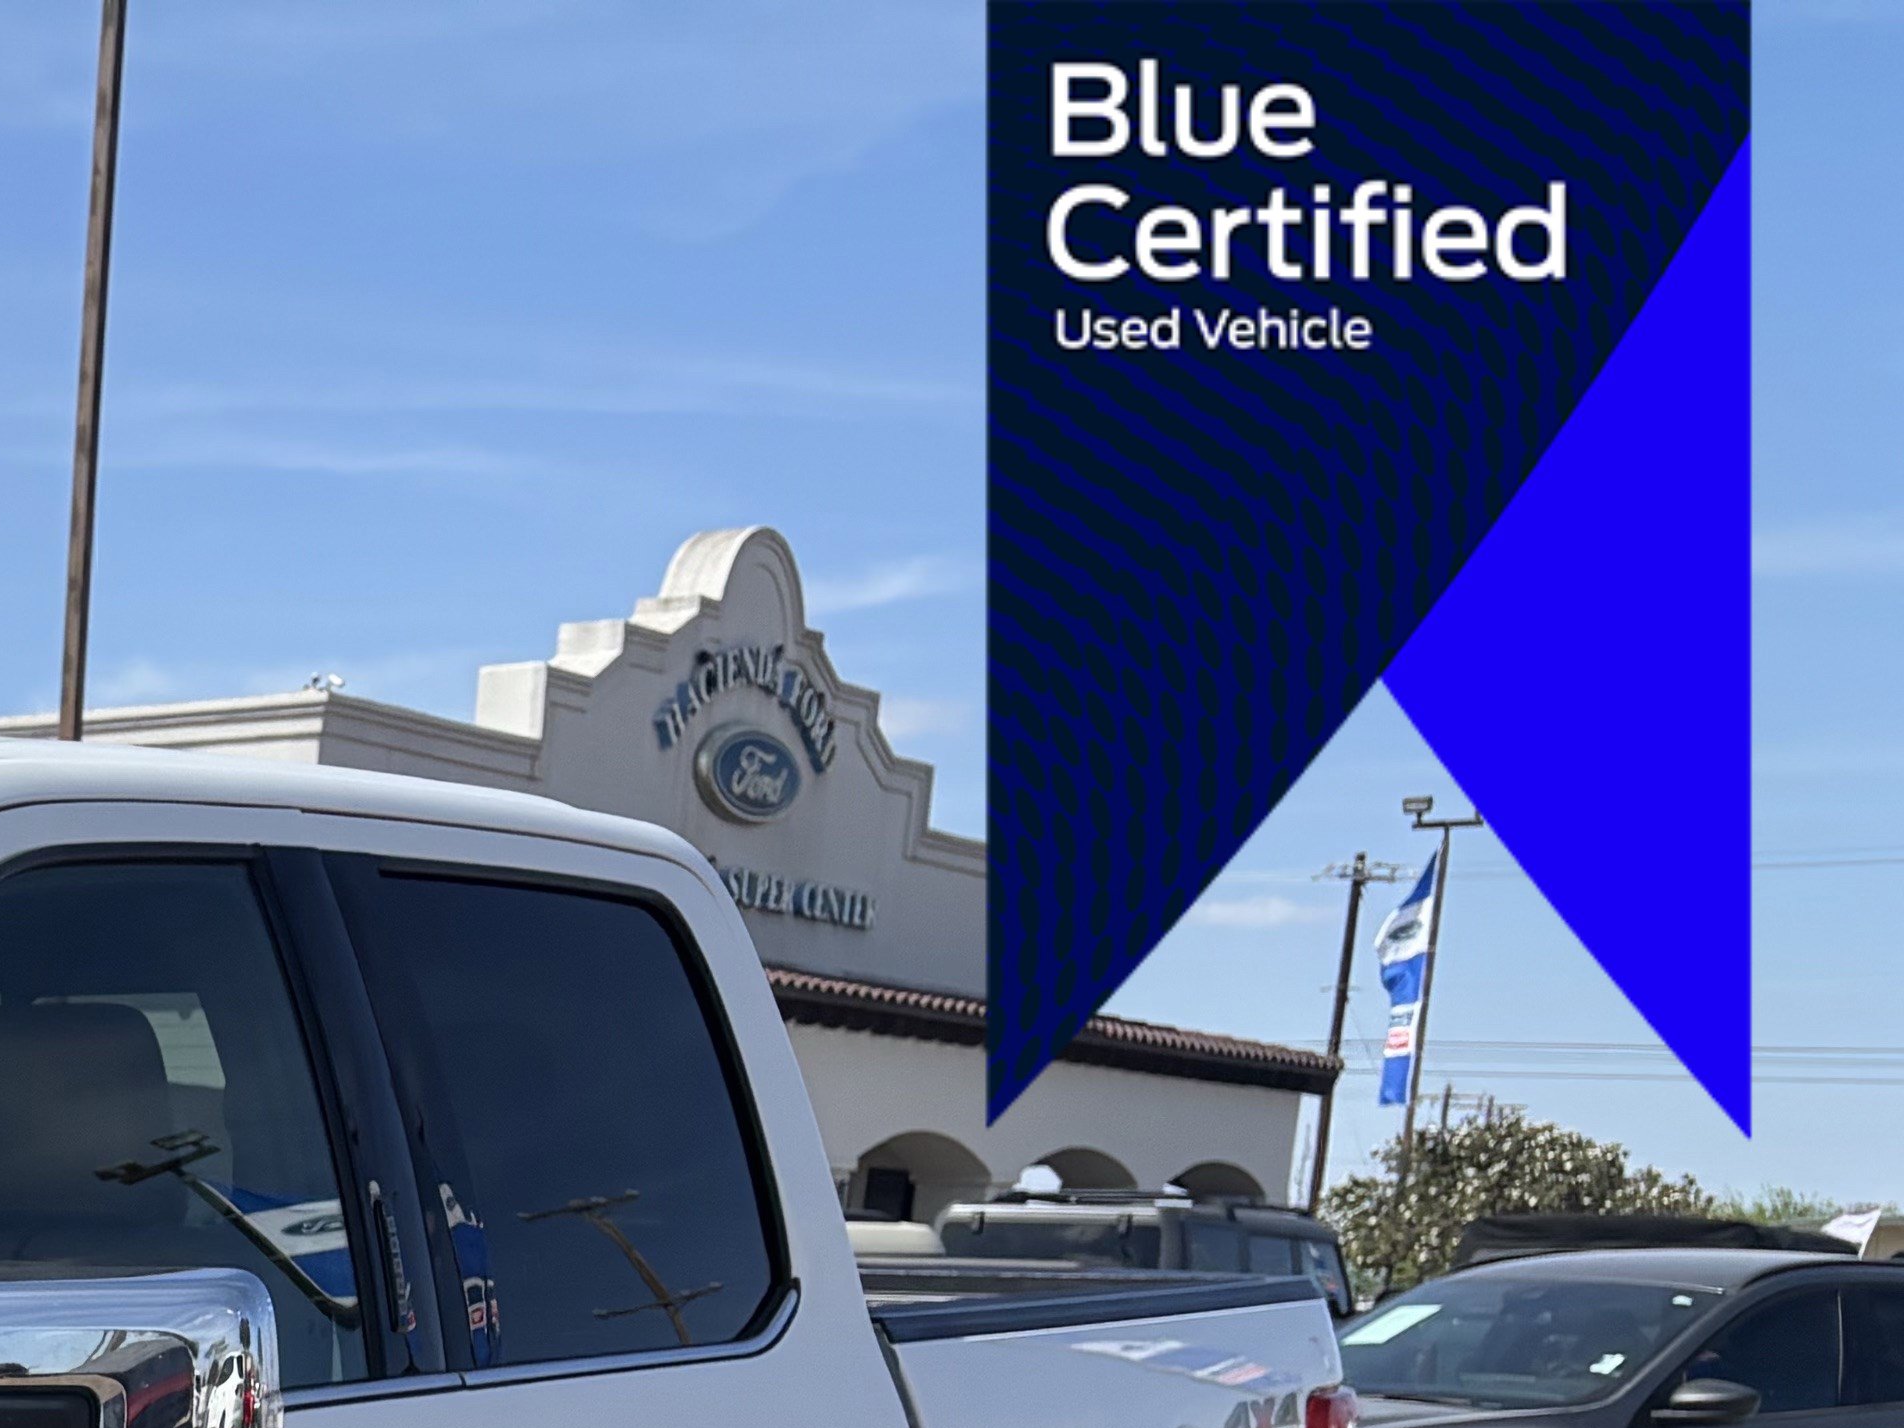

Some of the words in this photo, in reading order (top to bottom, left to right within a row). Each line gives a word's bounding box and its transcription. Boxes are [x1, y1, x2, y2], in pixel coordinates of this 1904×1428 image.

[732, 745, 788, 801] Ford
[723, 867, 792, 915] SUPER
[797, 880, 877, 930] CENTER
